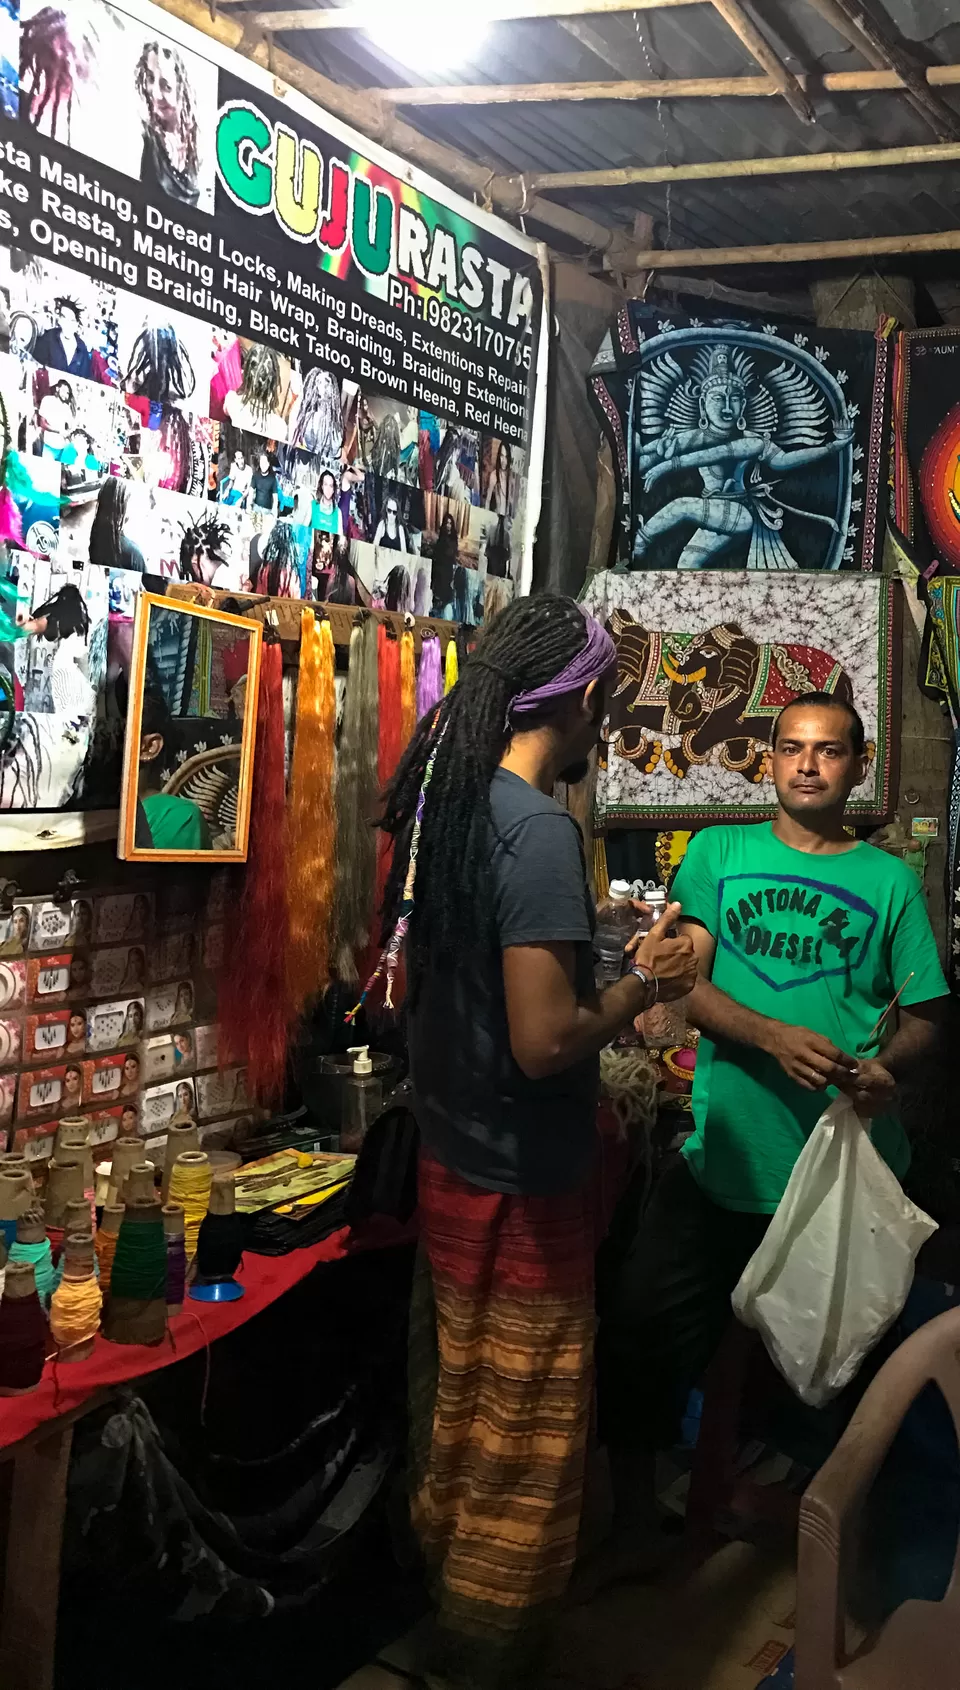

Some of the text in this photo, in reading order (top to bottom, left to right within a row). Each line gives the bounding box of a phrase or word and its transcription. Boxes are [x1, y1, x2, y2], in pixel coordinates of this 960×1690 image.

[30, 218, 138, 287] Opening
[147, 265, 242, 327] Braiding,
[250, 308, 300, 349] Black
[305, 333, 355, 374] Tatoo,
[361, 357, 408, 394] Brown
[413, 380, 460, 418] Heena,
[465, 401, 491, 427] Red
[494, 413, 528, 443] Heena
[40, 154, 138, 224] Making,
[146, 204, 212, 254] Dread
[219, 238, 282, 288] Locks,
[287, 270, 346, 319] Making
[351, 301, 407, 347] Dreads,
[412, 331, 484, 378] Extentions
[42, 188, 122, 248] Rasta,
[133, 229, 214, 287] Making
[223, 269, 263, 304] Hair
[270, 289, 319, 333] Wrap,
[327, 317, 395, 367] Braiding,
[403, 351, 462, 396] Braiding
[467, 379, 529, 421] Extentions
[725, 887, 822, 937] DAYTONA
[744, 925, 823, 966] DIESEL
